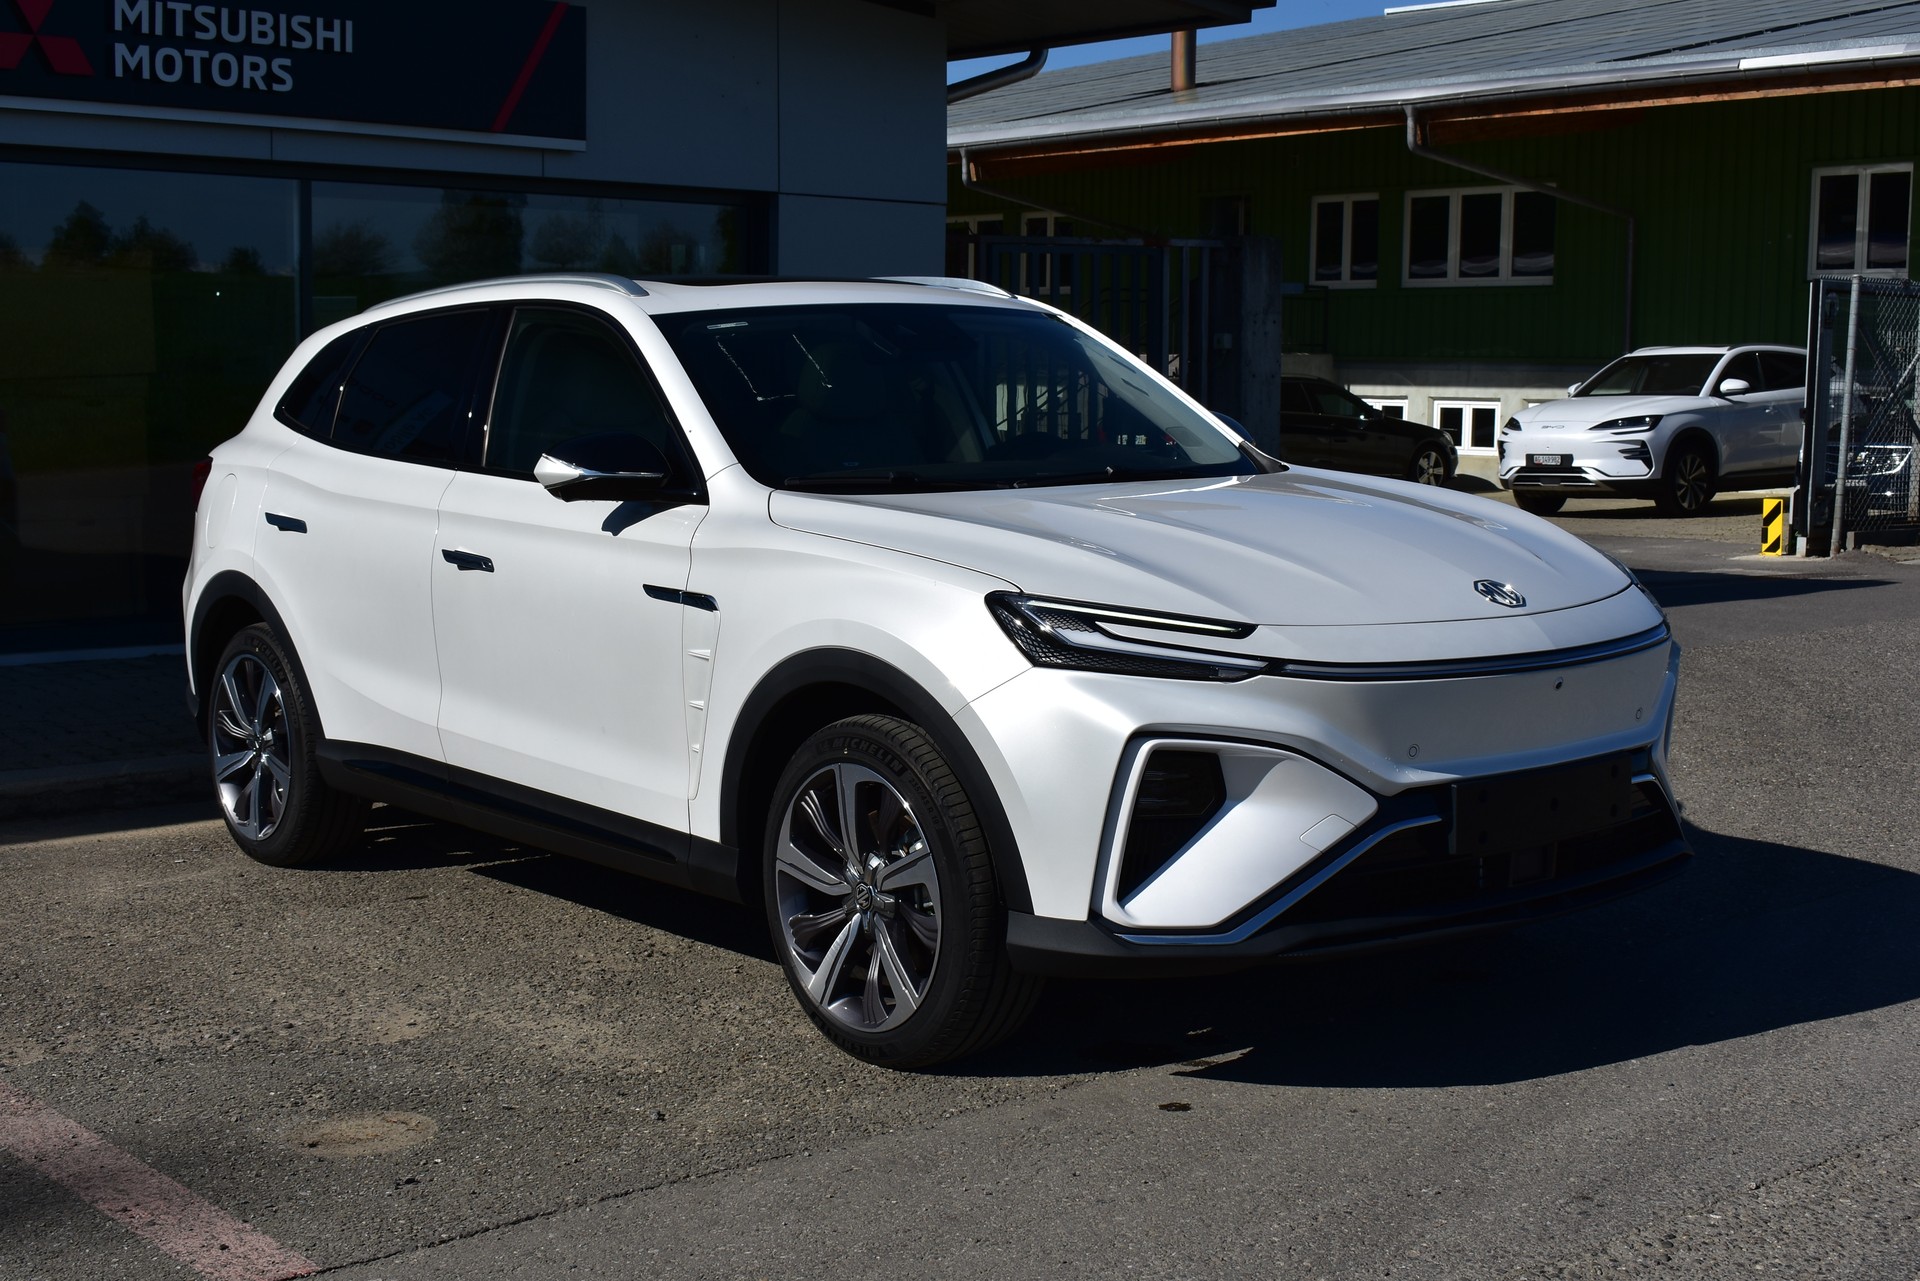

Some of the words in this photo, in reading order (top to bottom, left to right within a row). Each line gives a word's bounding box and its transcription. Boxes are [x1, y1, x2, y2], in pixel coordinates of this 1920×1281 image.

[114, 0, 353, 53] MITSUBISHI
[114, 43, 293, 92] MOTORS
[832, 737, 905, 775] MICHELIN
